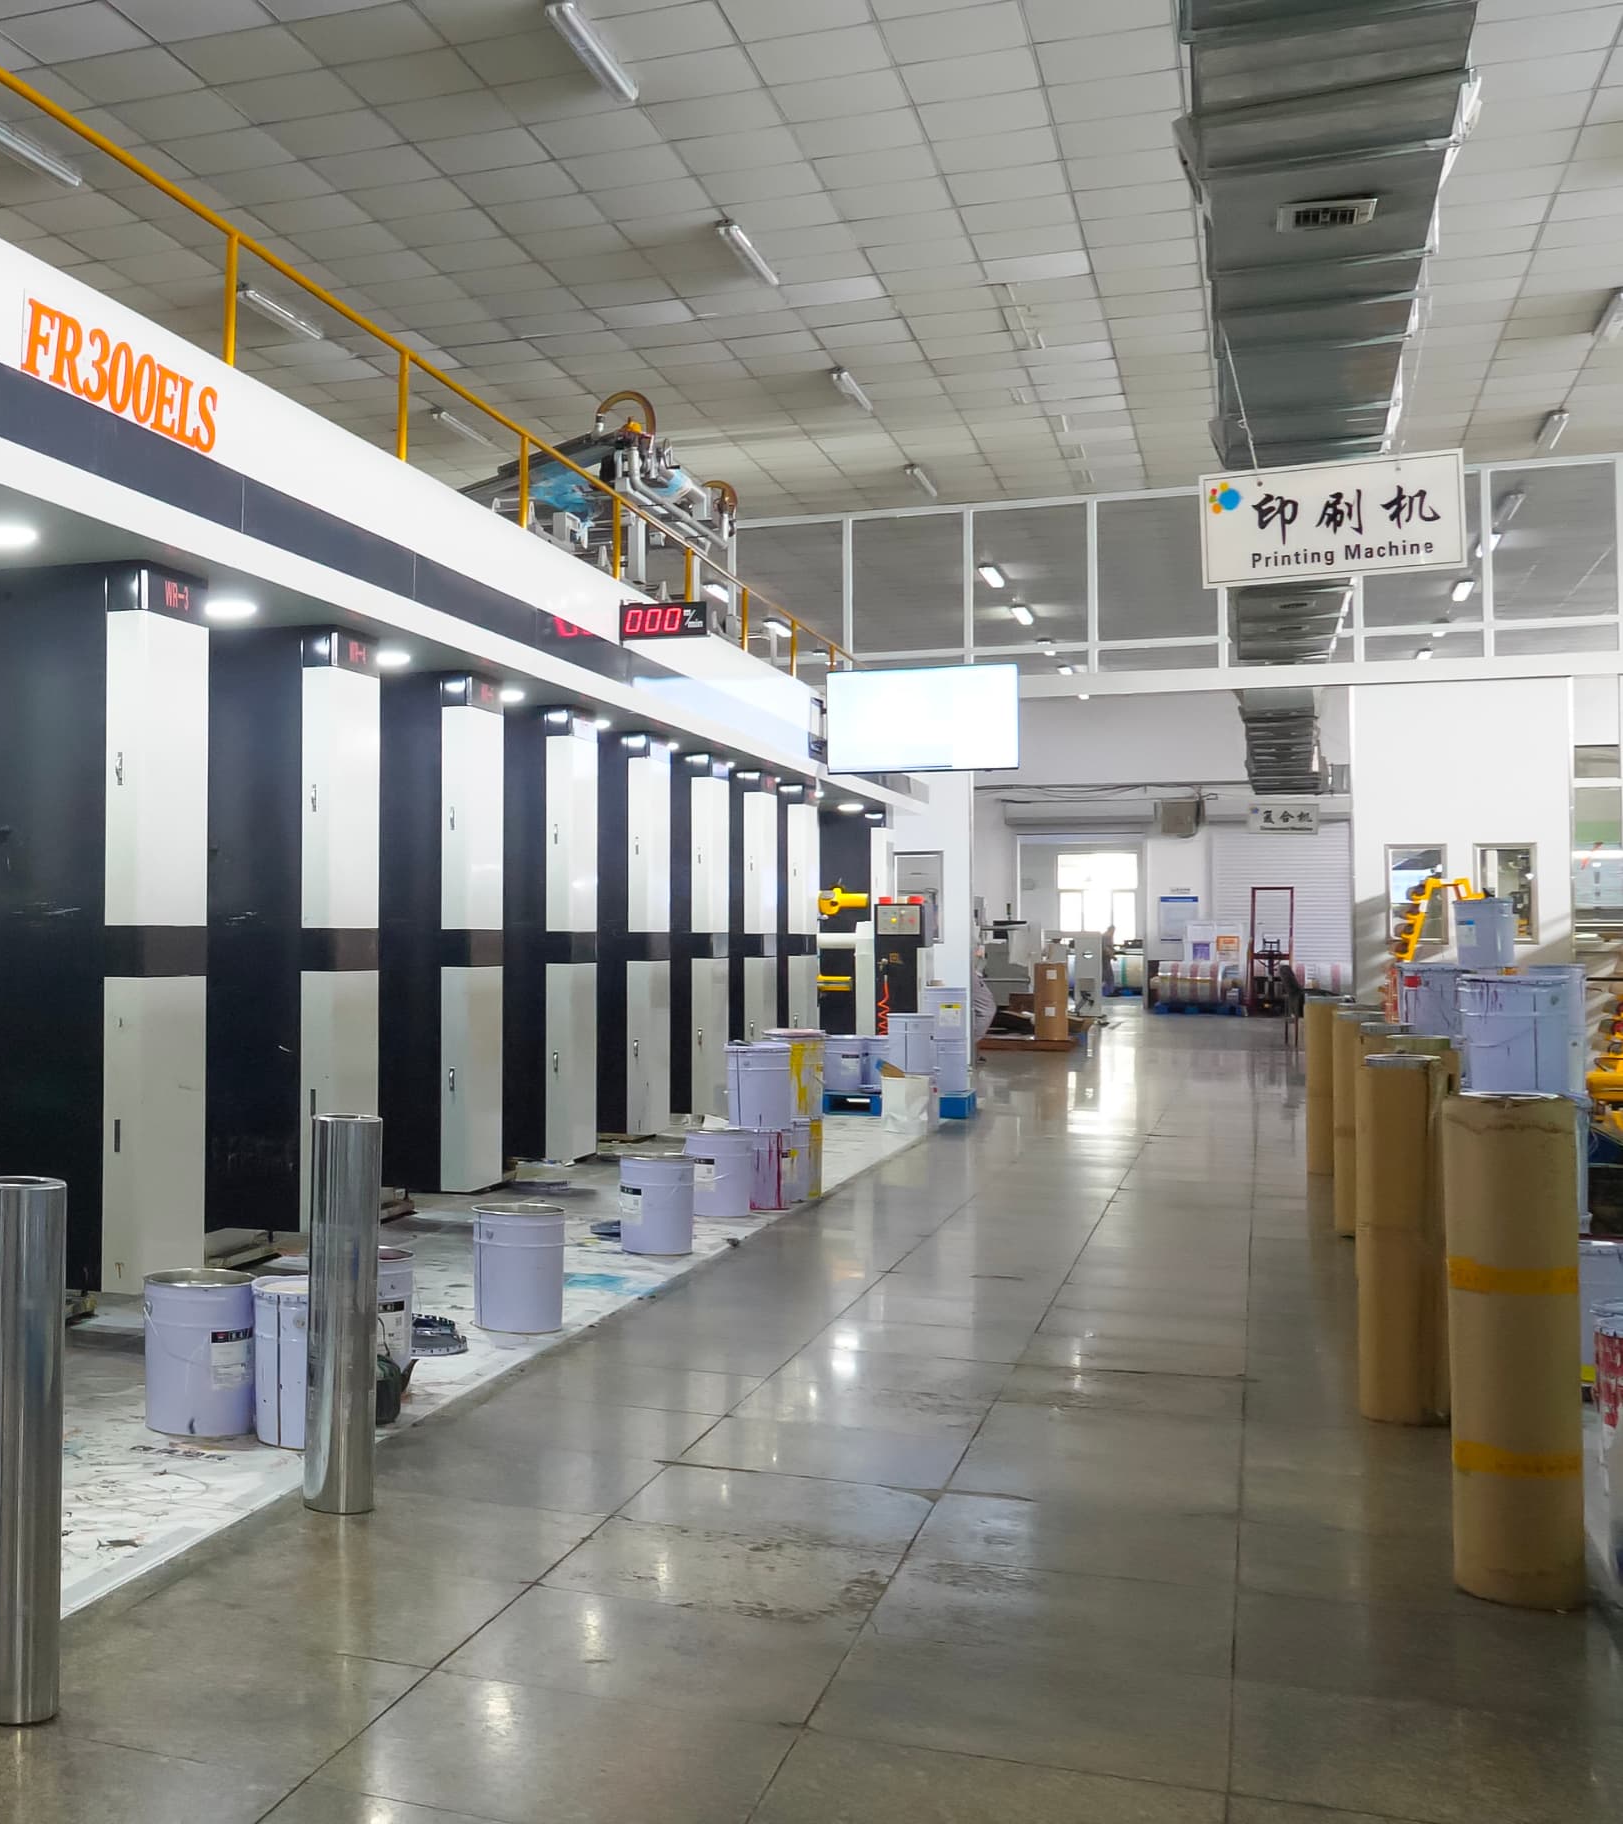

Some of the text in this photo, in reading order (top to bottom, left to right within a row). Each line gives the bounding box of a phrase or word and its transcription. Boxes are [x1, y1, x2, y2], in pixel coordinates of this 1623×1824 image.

[21, 297, 219, 454] FR300ELS
[1251, 485, 1441, 545] 印刷机
[1251, 539, 1434, 569] Printing Machine
[625, 607, 682, 633] 000
